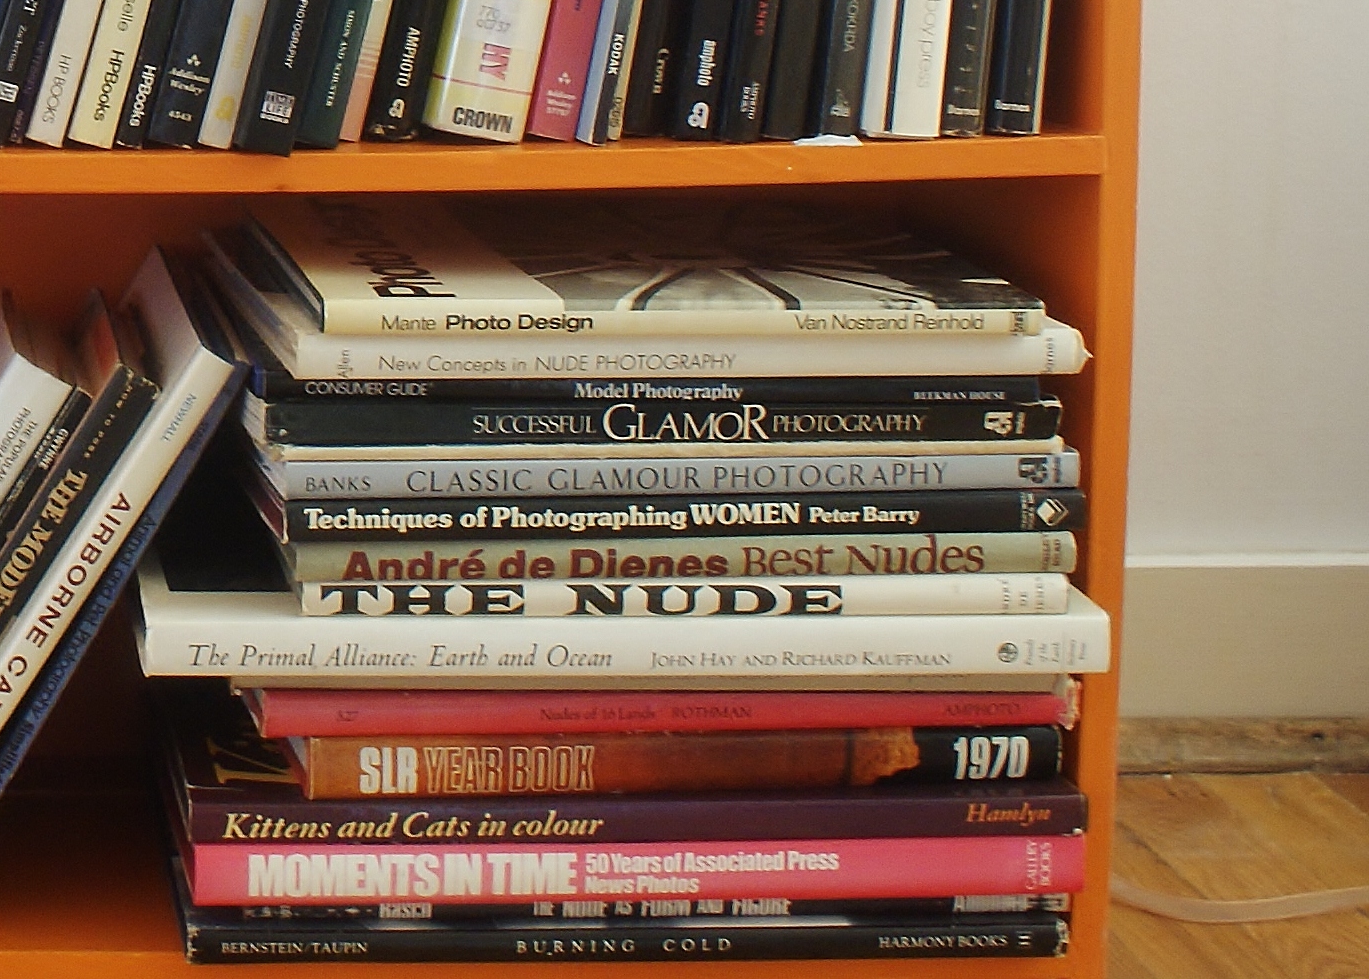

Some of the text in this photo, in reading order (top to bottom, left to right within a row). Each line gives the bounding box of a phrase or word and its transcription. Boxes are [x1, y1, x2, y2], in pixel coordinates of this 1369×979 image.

[393, 25, 421, 88] AMPHOTO
[90, 47, 125, 123] HPBooks
[452, 107, 513, 134] CROWN
[381, 312, 983, 333] Mante Photo Design Van Nostrand Reinhold
[472, 403, 927, 441] SUCCESSFUL GLAMOR PHOTOGRAPHY
[304, 502, 919, 532] Techniques of Photographing WOMEN Peter Barry
[23, 491, 136, 648] AIRBORNE
[344, 533, 984, 582] André de Dienes Best Nudes
[320, 584, 843, 616] THE NUDE
[188, 642, 612, 670] The Primal Alliance: Earth and Ocean
[358, 734, 1031, 795] SLR YEAR BOOK 1970
[222, 799, 1052, 841] Kittens and Cats in colour Hamlyn
[247, 850, 577, 899] MOMENTS IN TIME
[515, 937, 732, 954] BURNING COLD
